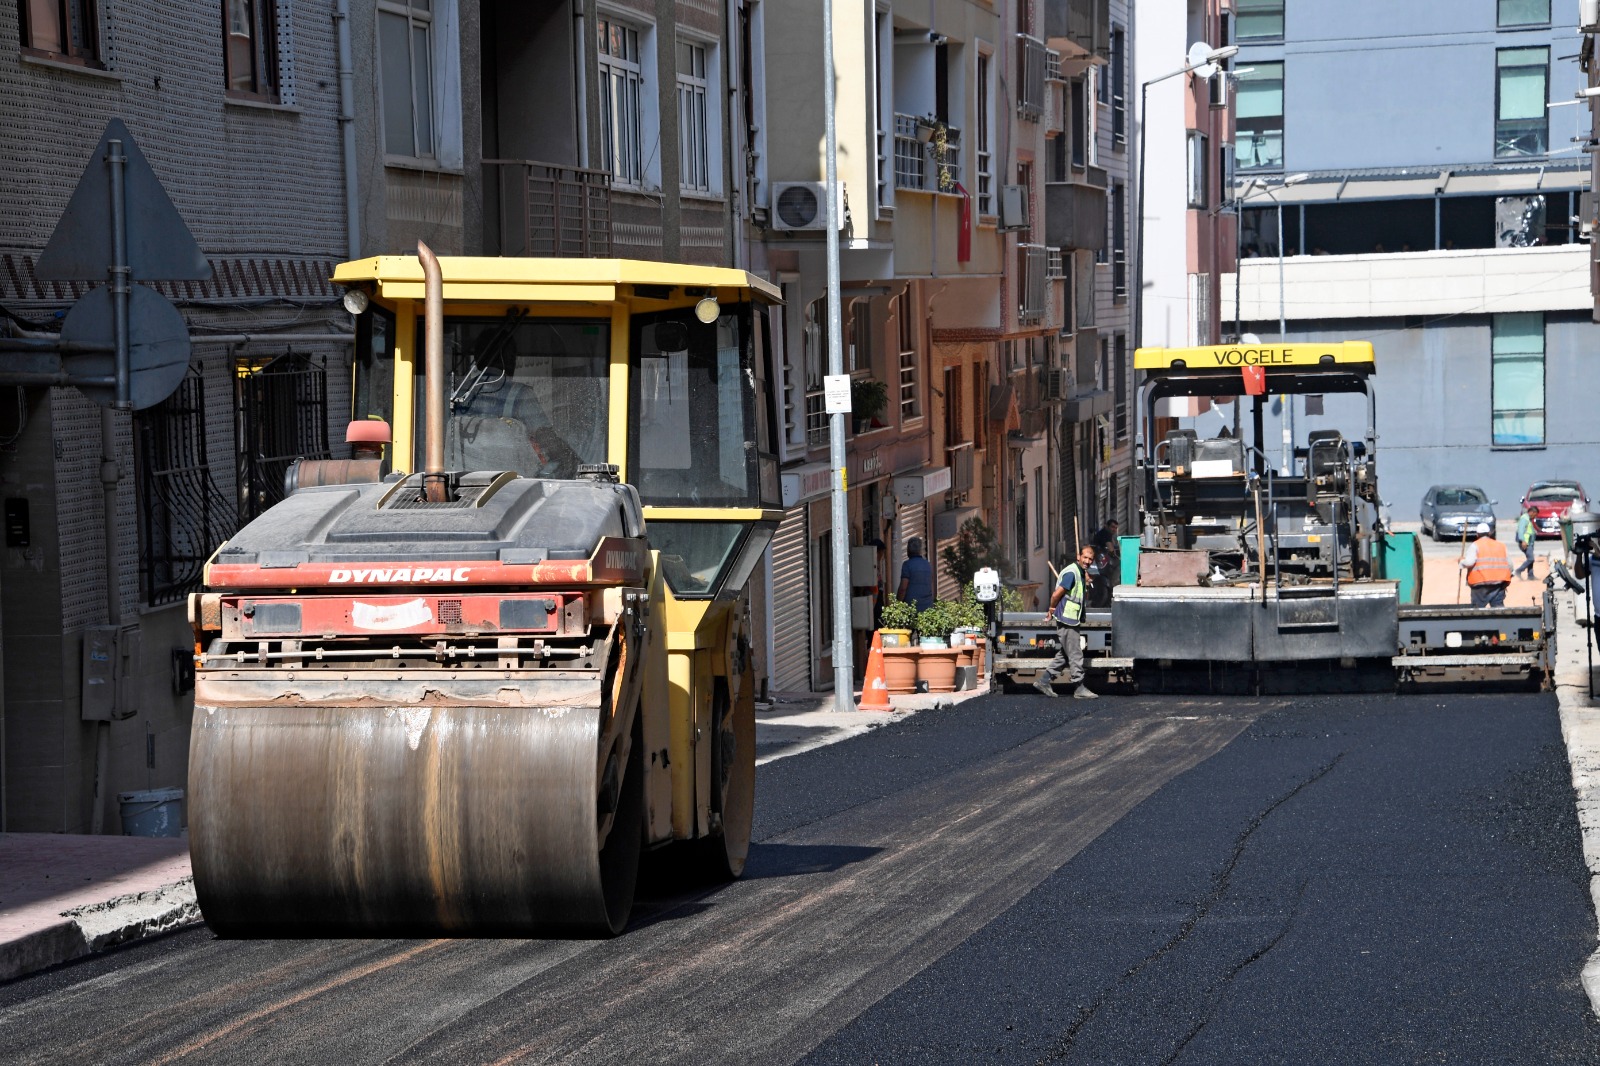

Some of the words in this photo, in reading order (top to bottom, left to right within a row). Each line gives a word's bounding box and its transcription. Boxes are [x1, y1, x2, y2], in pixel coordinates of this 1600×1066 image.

[1214, 347, 1293, 365] VÖGELE
[605, 550, 637, 570] DYNAPAC
[328, 567, 471, 583] DYNAPAC
